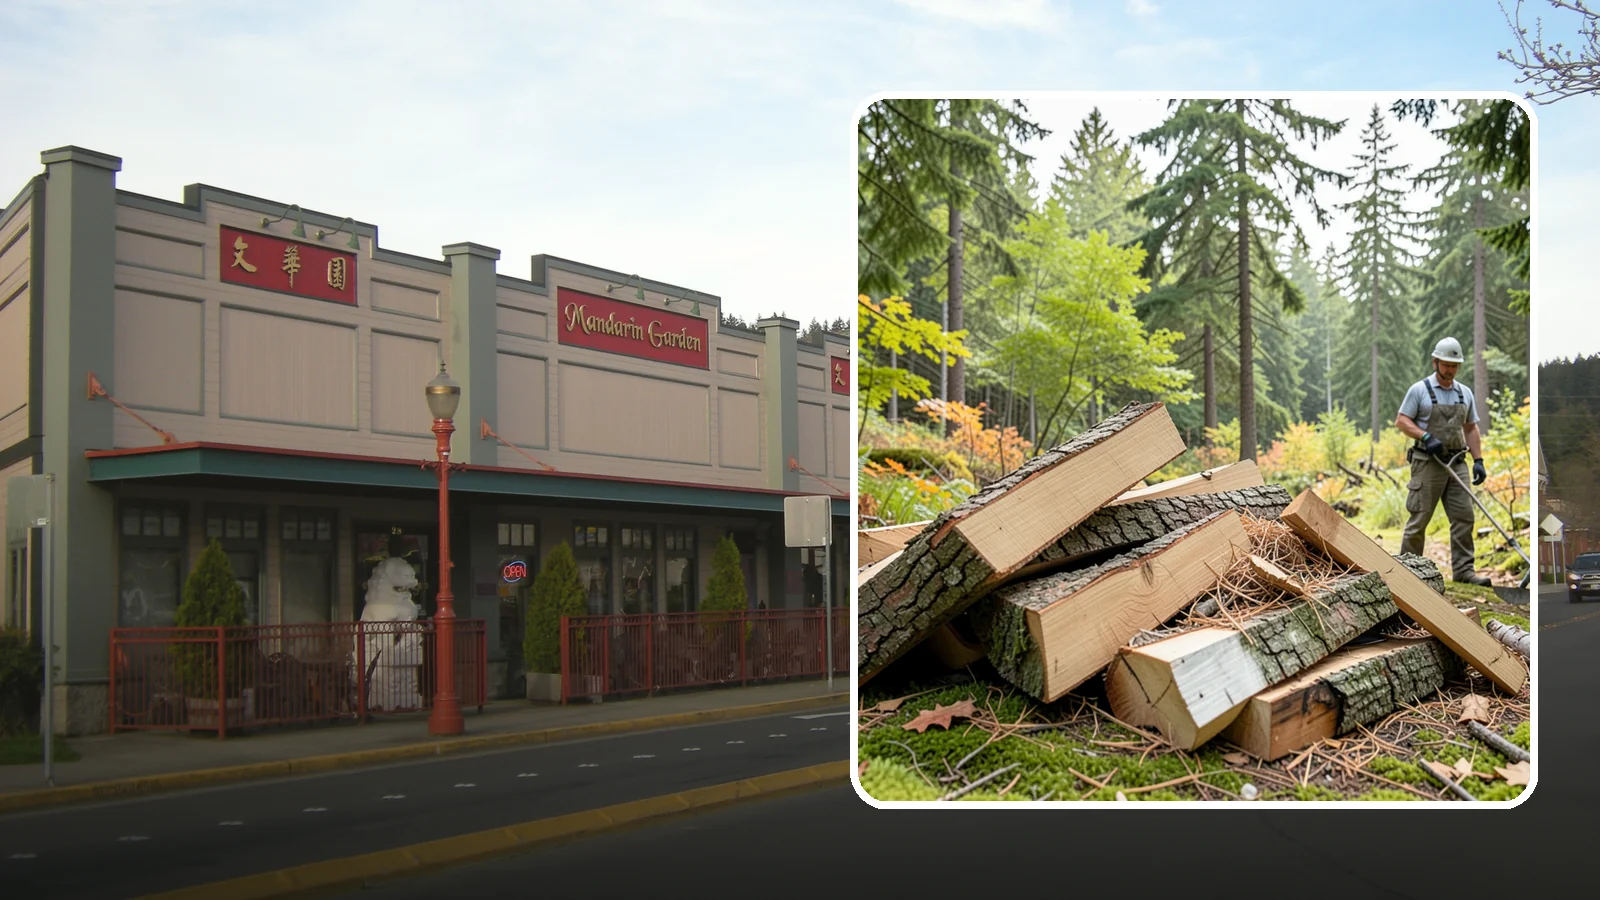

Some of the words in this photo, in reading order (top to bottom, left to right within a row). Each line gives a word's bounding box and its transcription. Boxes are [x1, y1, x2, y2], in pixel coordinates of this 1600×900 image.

[231, 236, 346, 291] 文華園
[564, 302, 644, 341] Mandarin
[648, 320, 701, 352] Garden
[503, 565, 526, 578] OPEN
